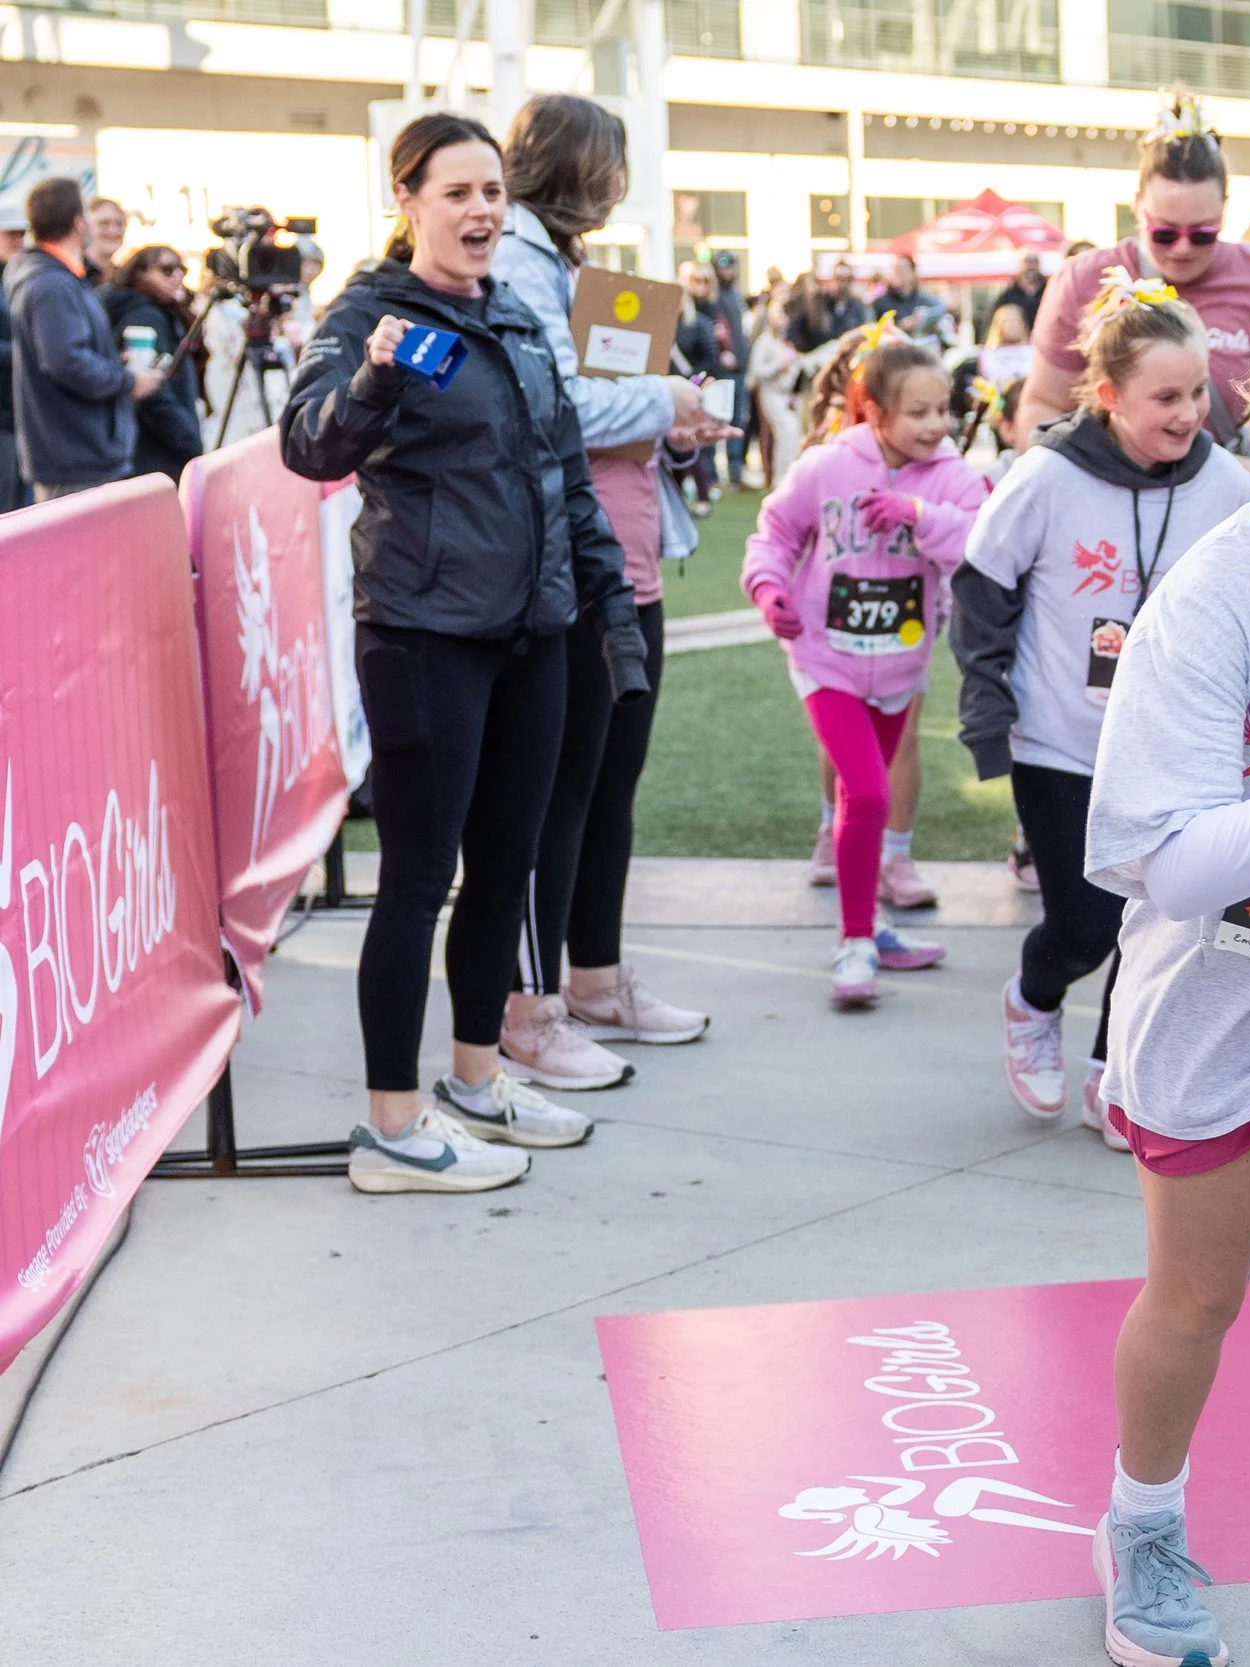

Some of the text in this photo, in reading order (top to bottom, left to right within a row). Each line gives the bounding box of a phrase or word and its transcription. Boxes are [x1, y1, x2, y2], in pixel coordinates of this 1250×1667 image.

[847, 600, 900, 630] 379
[20, 758, 177, 1080] BIOGirls
[45, 1194, 79, 1256] Provided
[845, 1320, 1020, 1472] BIOGirls
